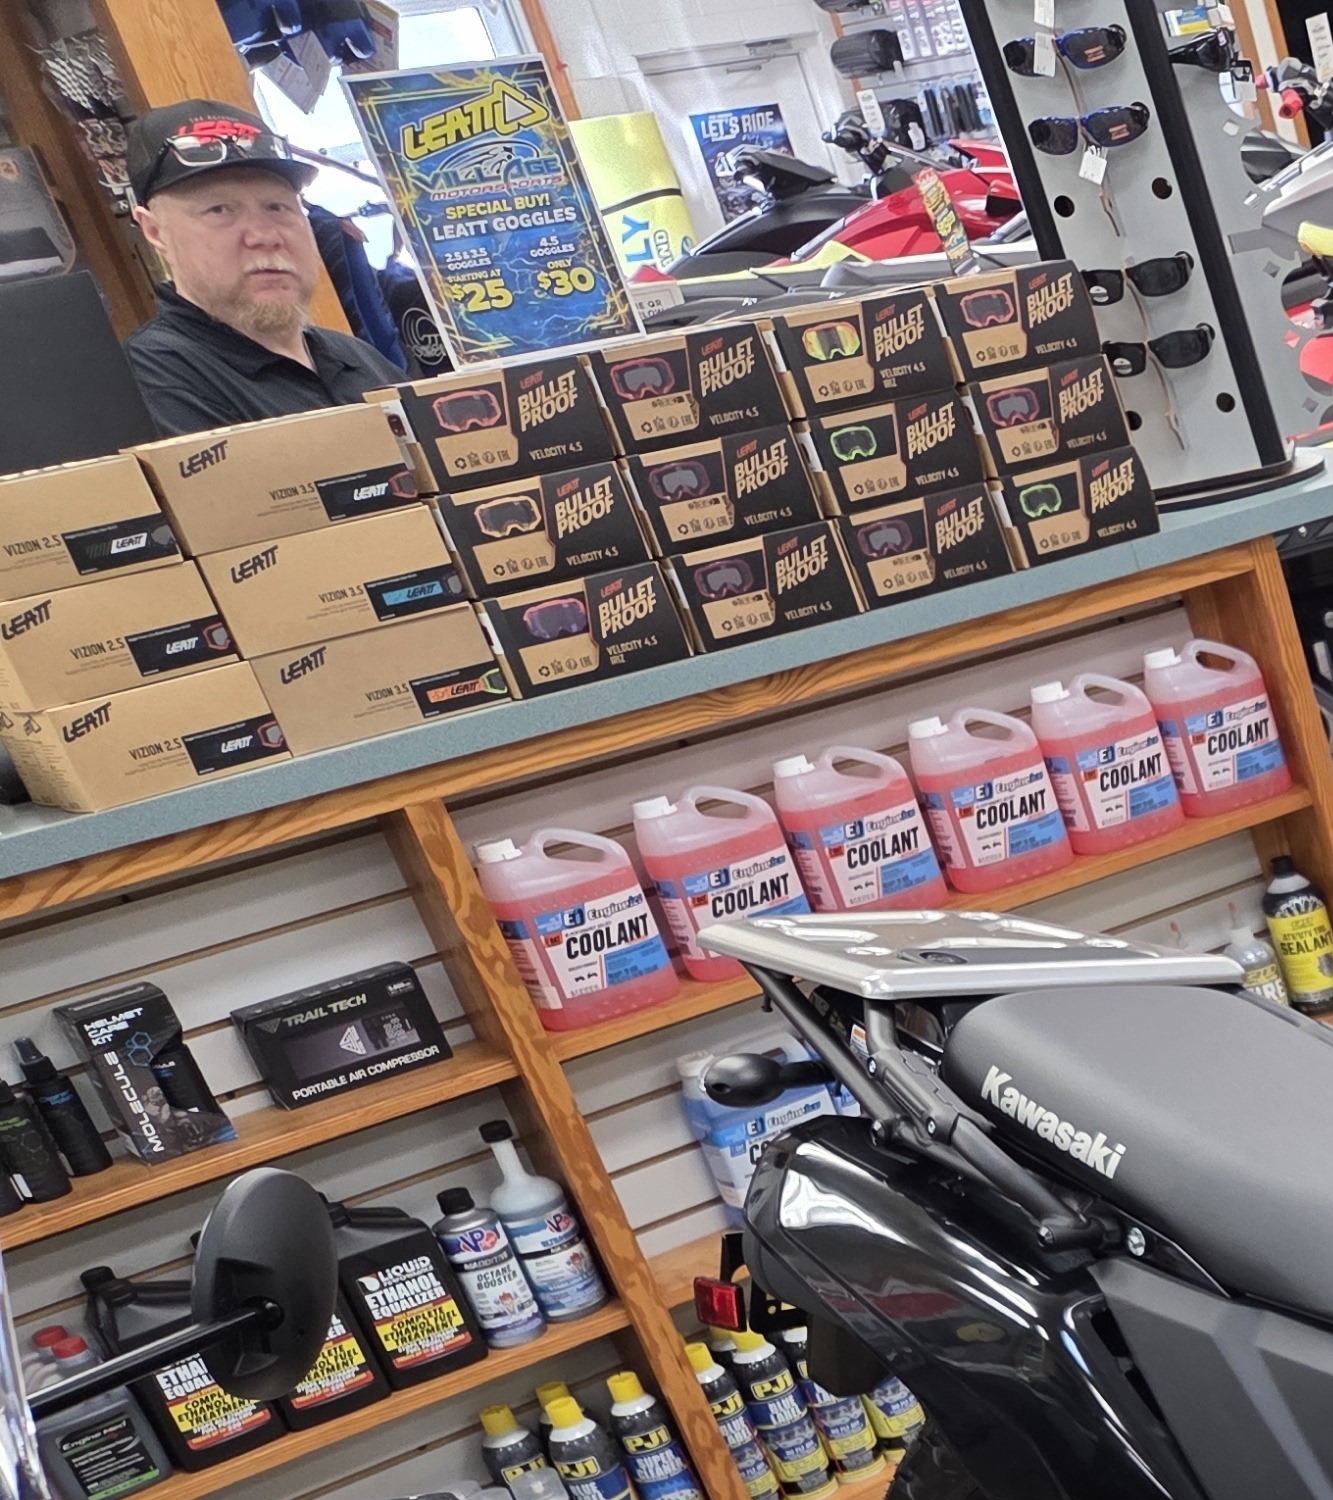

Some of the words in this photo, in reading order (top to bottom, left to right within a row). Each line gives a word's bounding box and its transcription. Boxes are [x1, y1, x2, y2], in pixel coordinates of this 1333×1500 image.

[701, 115, 740, 139] LET'S
[742, 111, 774, 133] RIDE
[410, 156, 563, 191] VILLAGE
[431, 175, 564, 200] MOTORSPORTS
[446, 200, 511, 220] SPECIAL
[515, 193, 551, 210] BUY!
[432, 220, 488, 241] LEATT
[493, 207, 577, 232] GOGGLES
[530, 243, 576, 258] GOGGLES
[540, 236, 560, 248] 4.5
[447, 258, 491, 271] GOGGLES
[546, 258, 572, 270] ONLY
[451, 279, 513, 312] $25
[537, 267, 595, 296] $30
[1026, 273, 1072, 312] BULLET
[873, 304, 923, 345] BULLET
[1028, 289, 1074, 329] PROOF
[875, 322, 925, 362] PROOF
[1036, 341, 1065, 355] VELOCITY
[699, 337, 753, 380] BULLET
[880, 364, 911, 378] VELOCITY
[701, 355, 755, 397] PROOF
[1058, 368, 1102, 406] BULLET
[518, 370, 575, 415] BULLET
[1060, 386, 1104, 423] PROOF
[520, 388, 578, 431] PROOF
[709, 410, 744, 425] VELOCITY
[906, 402, 954, 443] BULLET
[529, 445, 567, 460] VELOCITY
[908, 420, 956, 459] PROOF
[1066, 435, 1094, 448] VELOCITY
[180, 440, 228, 479] LEATT
[734, 438, 787, 481] BULLET
[269, 486, 300, 501] VIZION
[301, 482, 315, 494] 3.5
[353, 482, 388, 500] LEATT
[736, 458, 789, 499] PROOF
[915, 471, 946, 486] VELOCITY
[1089, 458, 1133, 496] BULLET
[554, 475, 612, 521] BULLET
[1092, 476, 1135, 513] PROOF
[557, 494, 614, 539] PROOF
[743, 511, 779, 525] VELOCITY
[935, 497, 983, 537] BULLET
[1096, 524, 1124, 538] VELOCITY
[3, 537, 42, 557] VIZION
[44, 534, 62, 548] 2.5
[116, 534, 143, 548] LEATT
[937, 515, 985, 554] PROOF
[231, 545, 278, 584] LEATT
[566, 550, 602, 566] VELOCITY
[775, 534, 827, 579] BULLET
[943, 564, 973, 579] VELOCITY
[777, 553, 829, 595] PROOF
[318, 588, 349, 604] VIZION
[350, 585, 364, 597] 3.5
[406, 583, 437, 598] LEATT
[598, 577, 654, 621] BULLET
[1, 599, 51, 641] LEATT
[601, 596, 656, 639] PROOF
[784, 607, 818, 620] VELOCITY
[69, 643, 106, 660] VIZION
[106, 638, 124, 651] 2.5
[166, 637, 198, 655] LEATT
[606, 640, 643, 656] VELOCITY
[281, 646, 327, 684] LEATT
[365, 686, 394, 702] VIZION
[395, 683, 409, 695] 3.5
[451, 681, 479, 696] LEATT
[62, 702, 112, 743] LEATT
[1208, 718, 1269, 756] COOLANT
[129, 743, 163, 760] VIZION
[164, 738, 182, 751] 2.5
[221, 735, 253, 754] LEATT
[1100, 753, 1161, 792] COOLANT
[976, 789, 1046, 829] COOLANT
[847, 826, 919, 869] COOLANT
[712, 873, 789, 918] COOLANT
[566, 913, 650, 960] COOLANT
[1280, 930, 1333, 956] SEALANT
[84, 1006, 144, 1033] HELMET
[281, 1008, 329, 1028] TRAIL
[330, 993, 367, 1013] TECH
[88, 1020, 130, 1039] CARE
[92, 1033, 114, 1047] KIT
[292, 1074, 347, 1101] PORTABLE
[349, 1067, 367, 1083] AIR
[366, 1045, 440, 1078] COMPRESSOR
[103, 1051, 164, 1153] MOLECULE
[981, 1065, 1126, 1179] Kawasaki
[378, 1256, 431, 1282] LIQUID
[476, 1263, 512, 1281] OCTANE
[477, 1270, 517, 1291] BOOSTER
[365, 1272, 441, 1310] ETHANOL
[371, 1286, 446, 1320] EQUALIZER
[384, 1320, 433, 1342] ETHANOL
[391, 1307, 444, 1331] COMPLETE
[395, 1321, 454, 1346] TREATMENT
[754, 1374, 792, 1398] PJ1
[625, 1427, 669, 1452] PJ1
